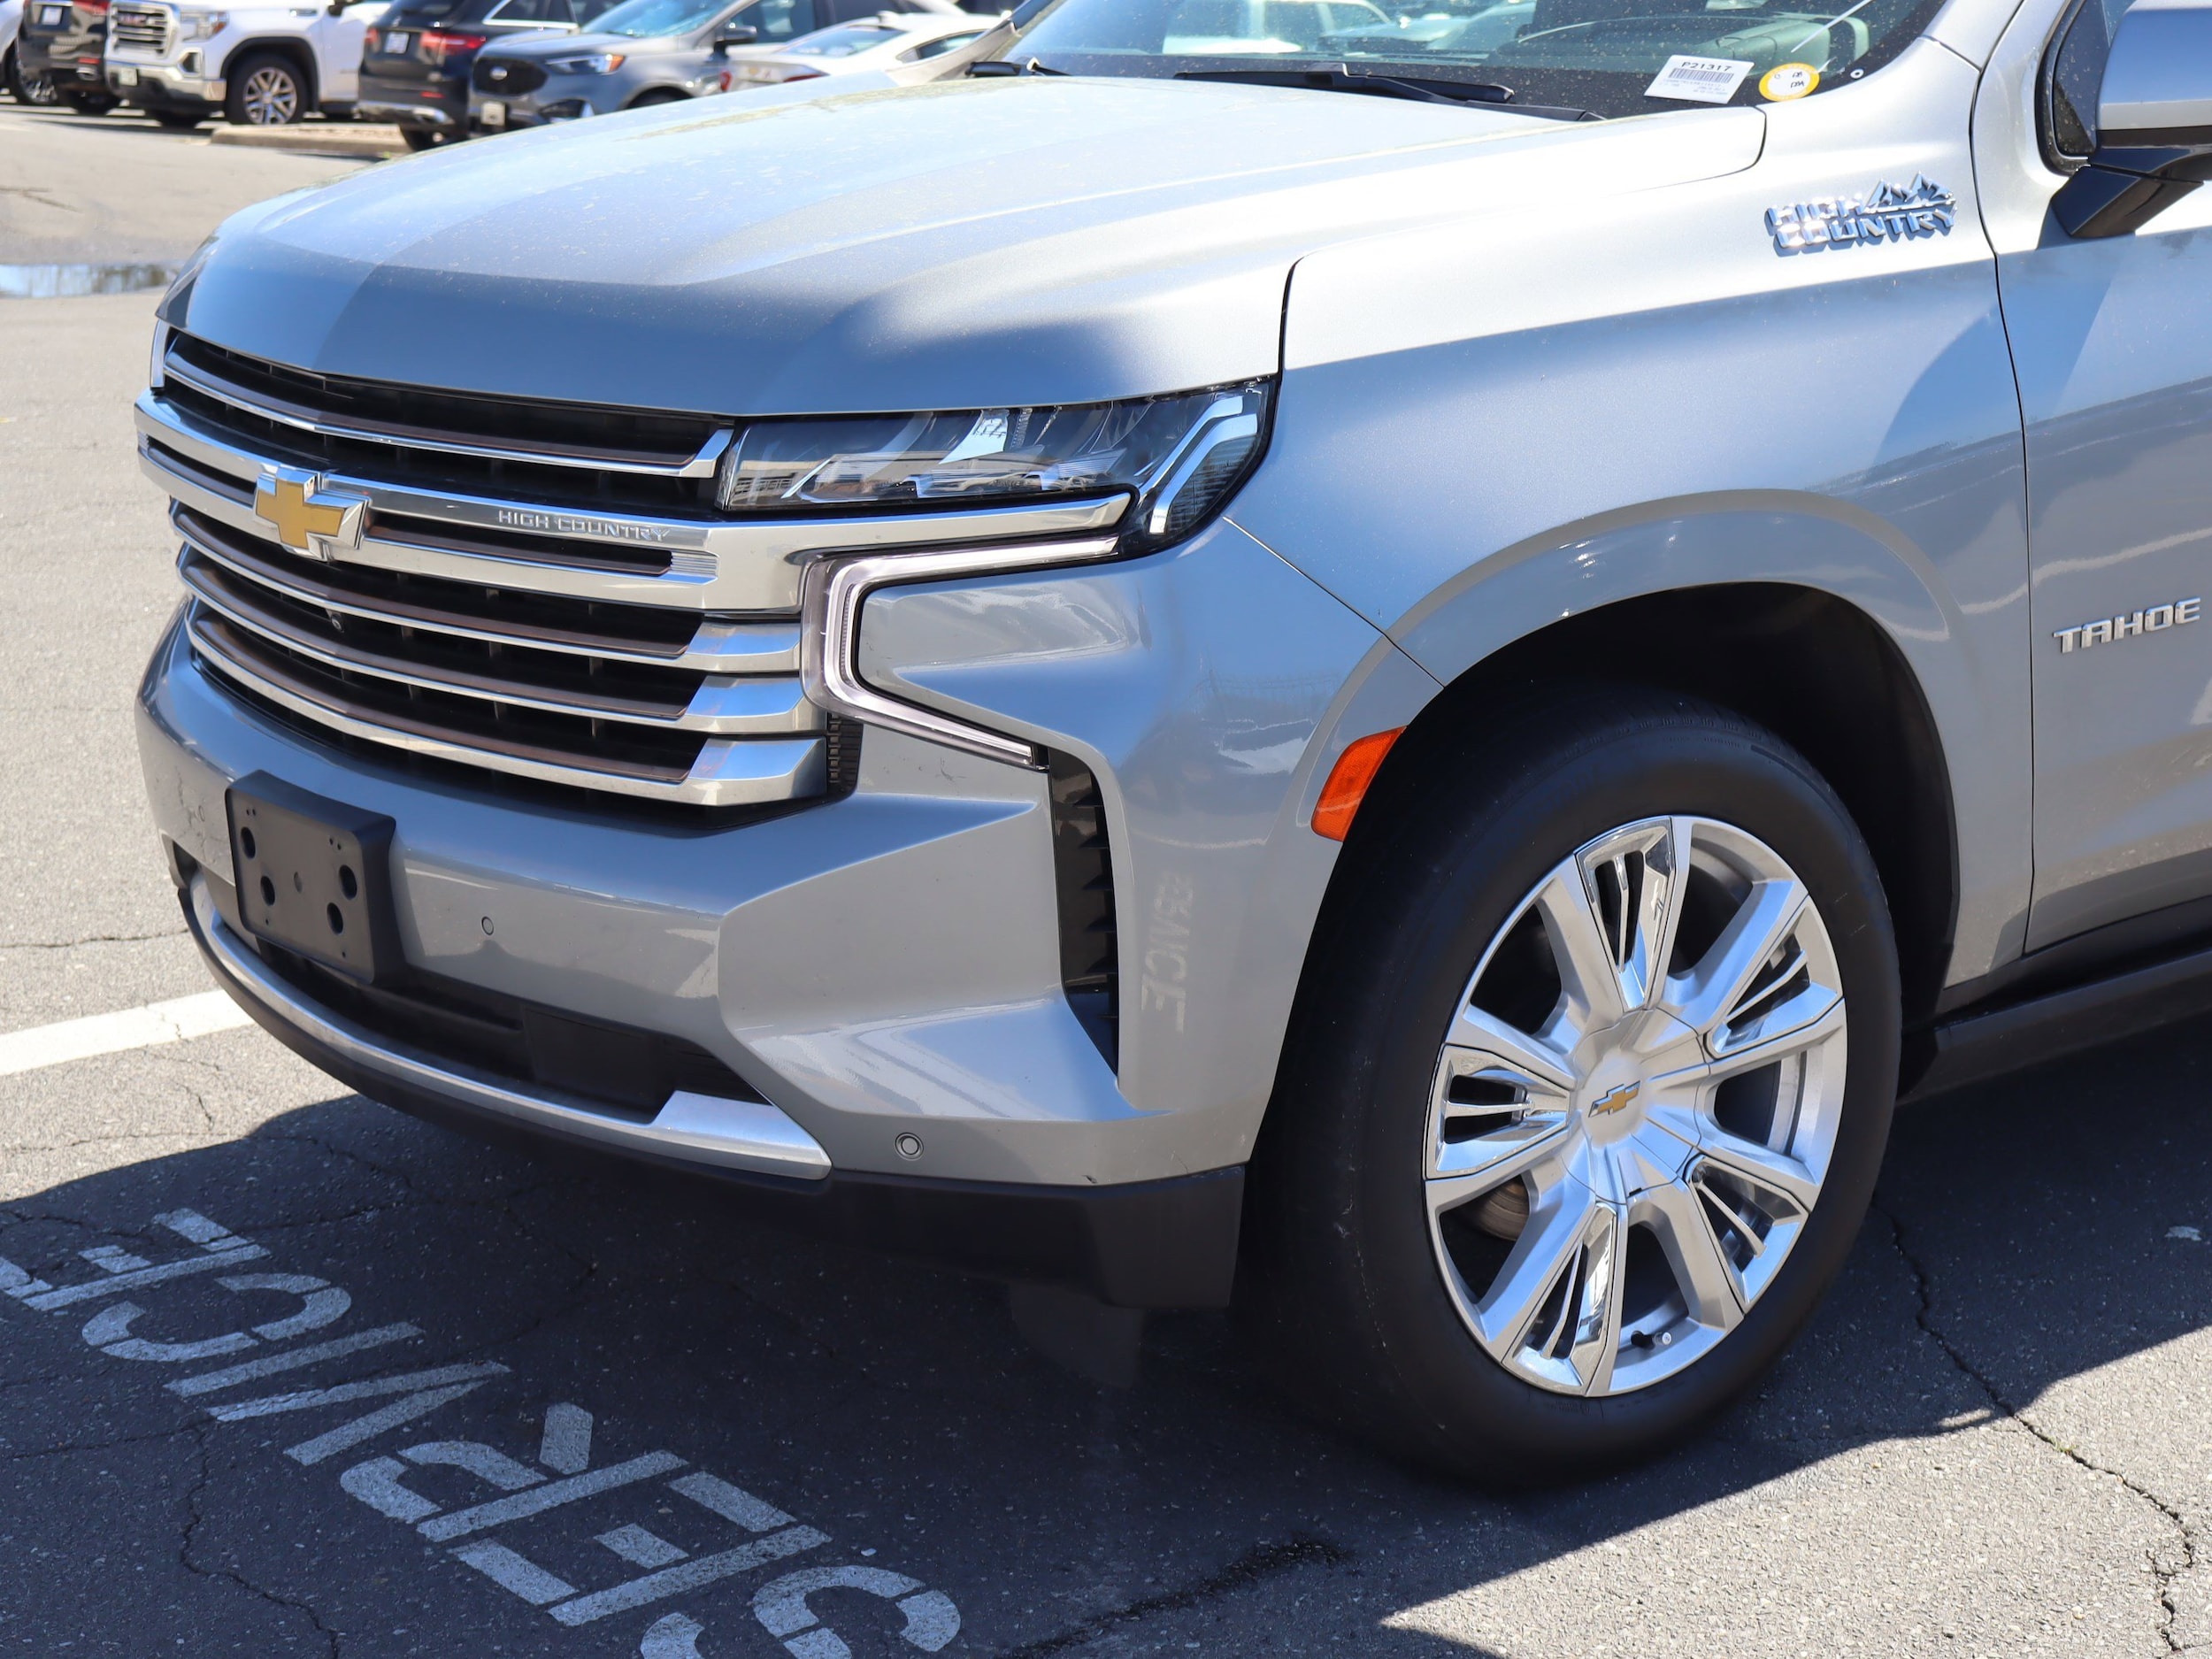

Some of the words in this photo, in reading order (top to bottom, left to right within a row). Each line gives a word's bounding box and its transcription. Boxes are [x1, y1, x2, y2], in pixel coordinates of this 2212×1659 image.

[1682, 61, 1732, 73] P21317
[1766, 194, 1863, 227] HIGH
[1776, 208, 1957, 248] COUNTRY
[498, 510, 549, 529] HIGH
[557, 517, 671, 542] COUNTRY
[2053, 596, 2201, 654] TAHOE
